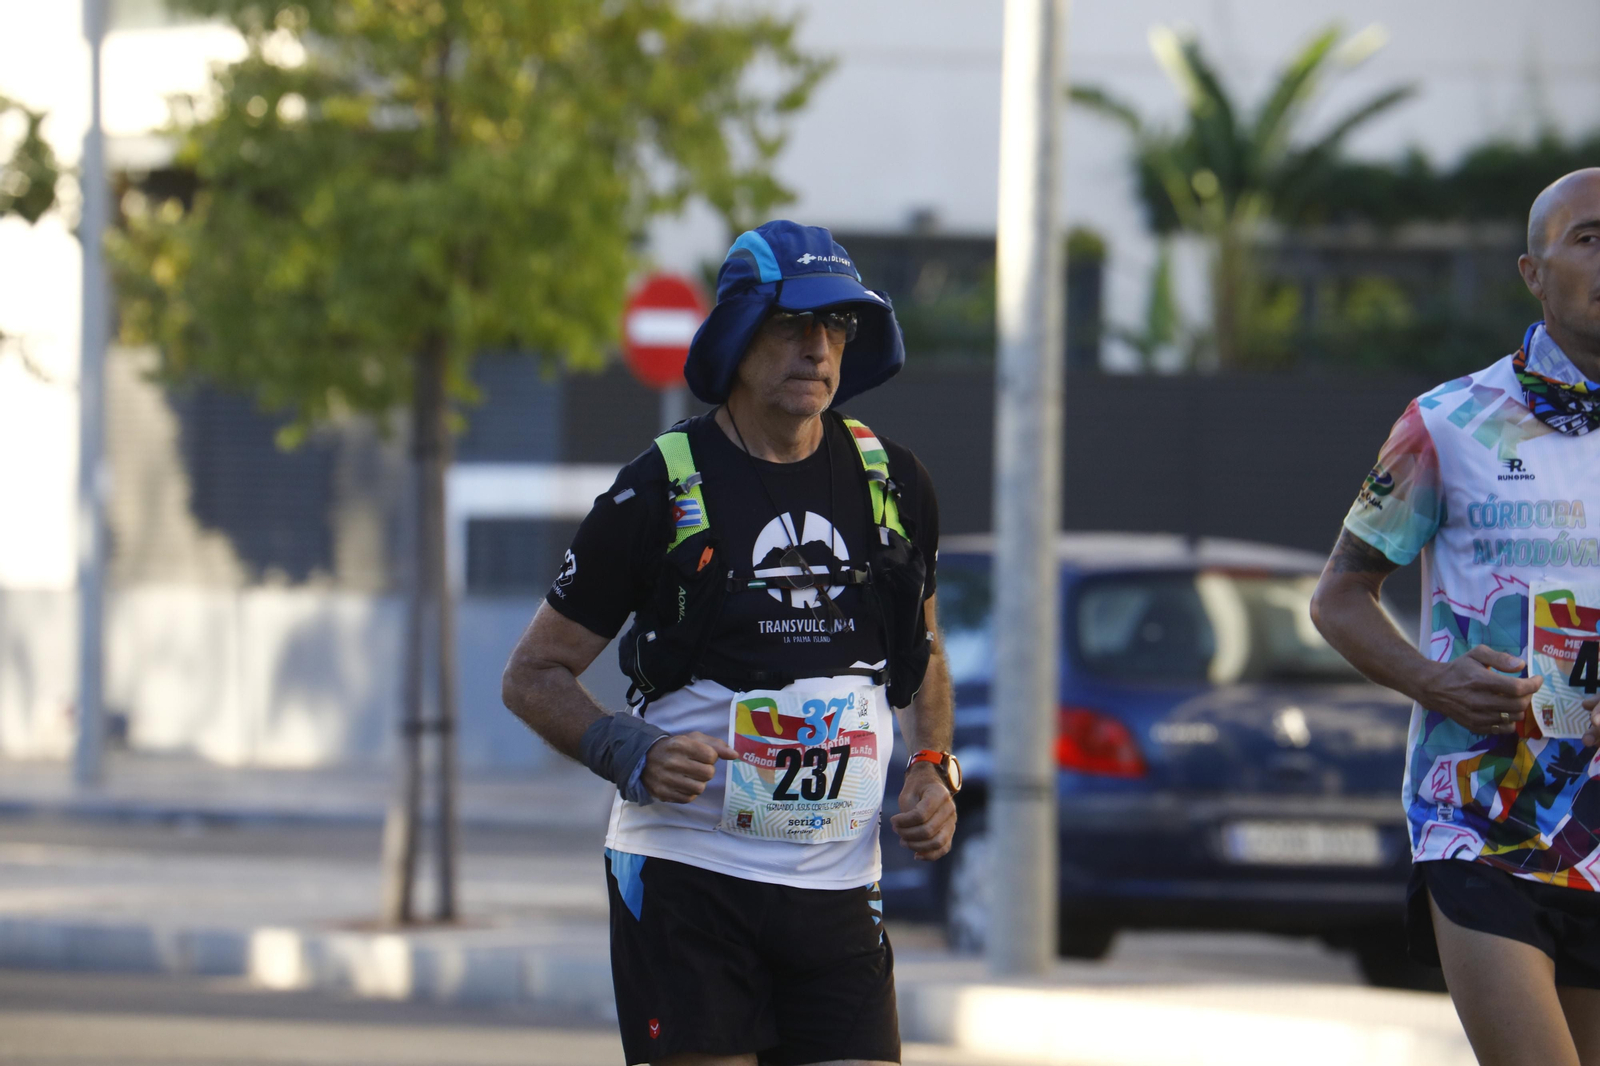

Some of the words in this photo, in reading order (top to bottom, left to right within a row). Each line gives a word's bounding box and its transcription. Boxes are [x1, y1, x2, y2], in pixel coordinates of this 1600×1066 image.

[817, 255, 851, 267] RAIDLIGHT
[1467, 493, 1586, 530] CÓRDOBA
[1472, 530, 1600, 568] ALMODÓVA
[757, 618, 855, 633] TRANSVULCNA
[793, 635, 811, 643] PALMA
[813, 635, 831, 643] ISLAND
[1542, 644, 1579, 659] CÓRDOB
[742, 752, 779, 767] CÓRDO
[772, 744, 850, 802] 237
